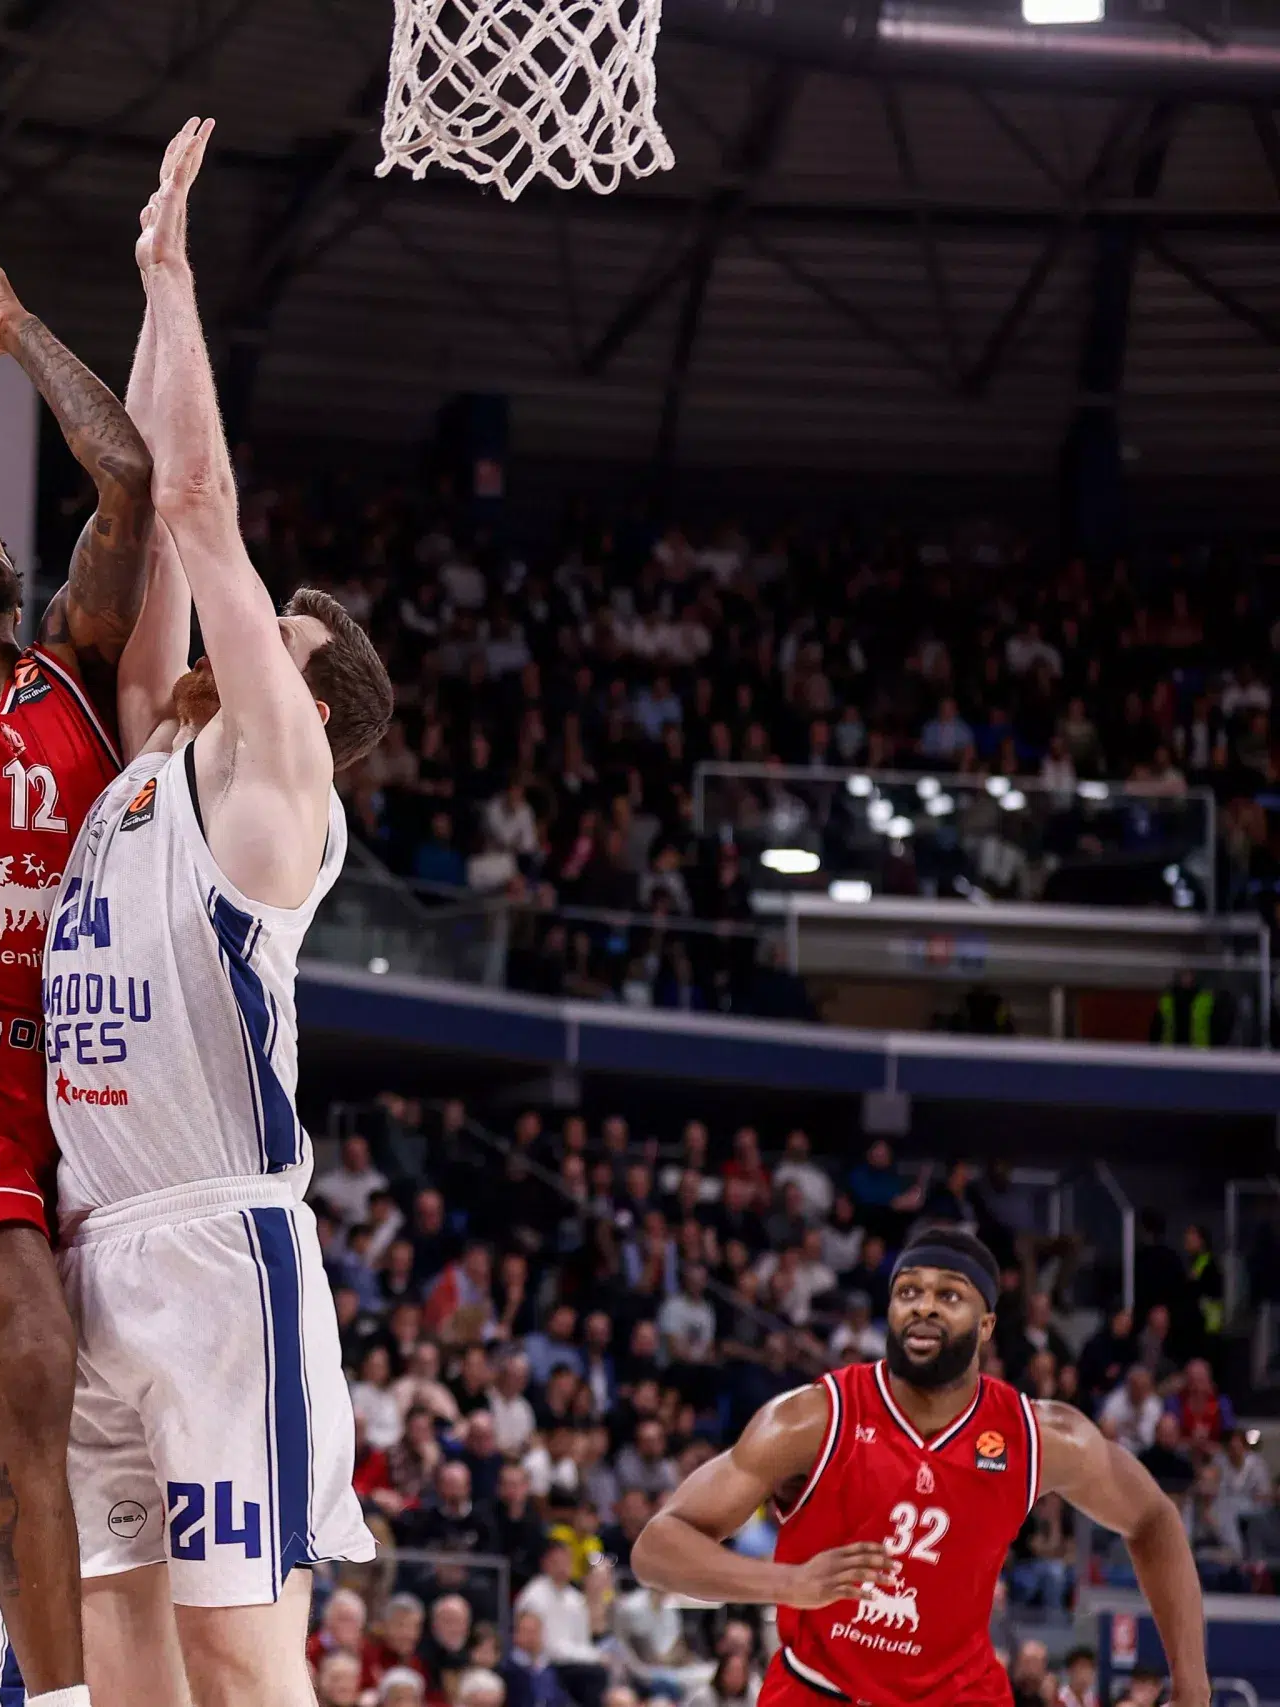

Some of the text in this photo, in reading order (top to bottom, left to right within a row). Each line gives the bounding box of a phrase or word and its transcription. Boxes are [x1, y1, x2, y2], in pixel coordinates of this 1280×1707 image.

[2, 758, 68, 833] 12
[51, 877, 111, 950] 24
[110, 1514, 145, 1525] GSA
[167, 1480, 262, 1561] 24
[883, 1501, 951, 1566] 32
[830, 1621, 922, 1656] plenitude
